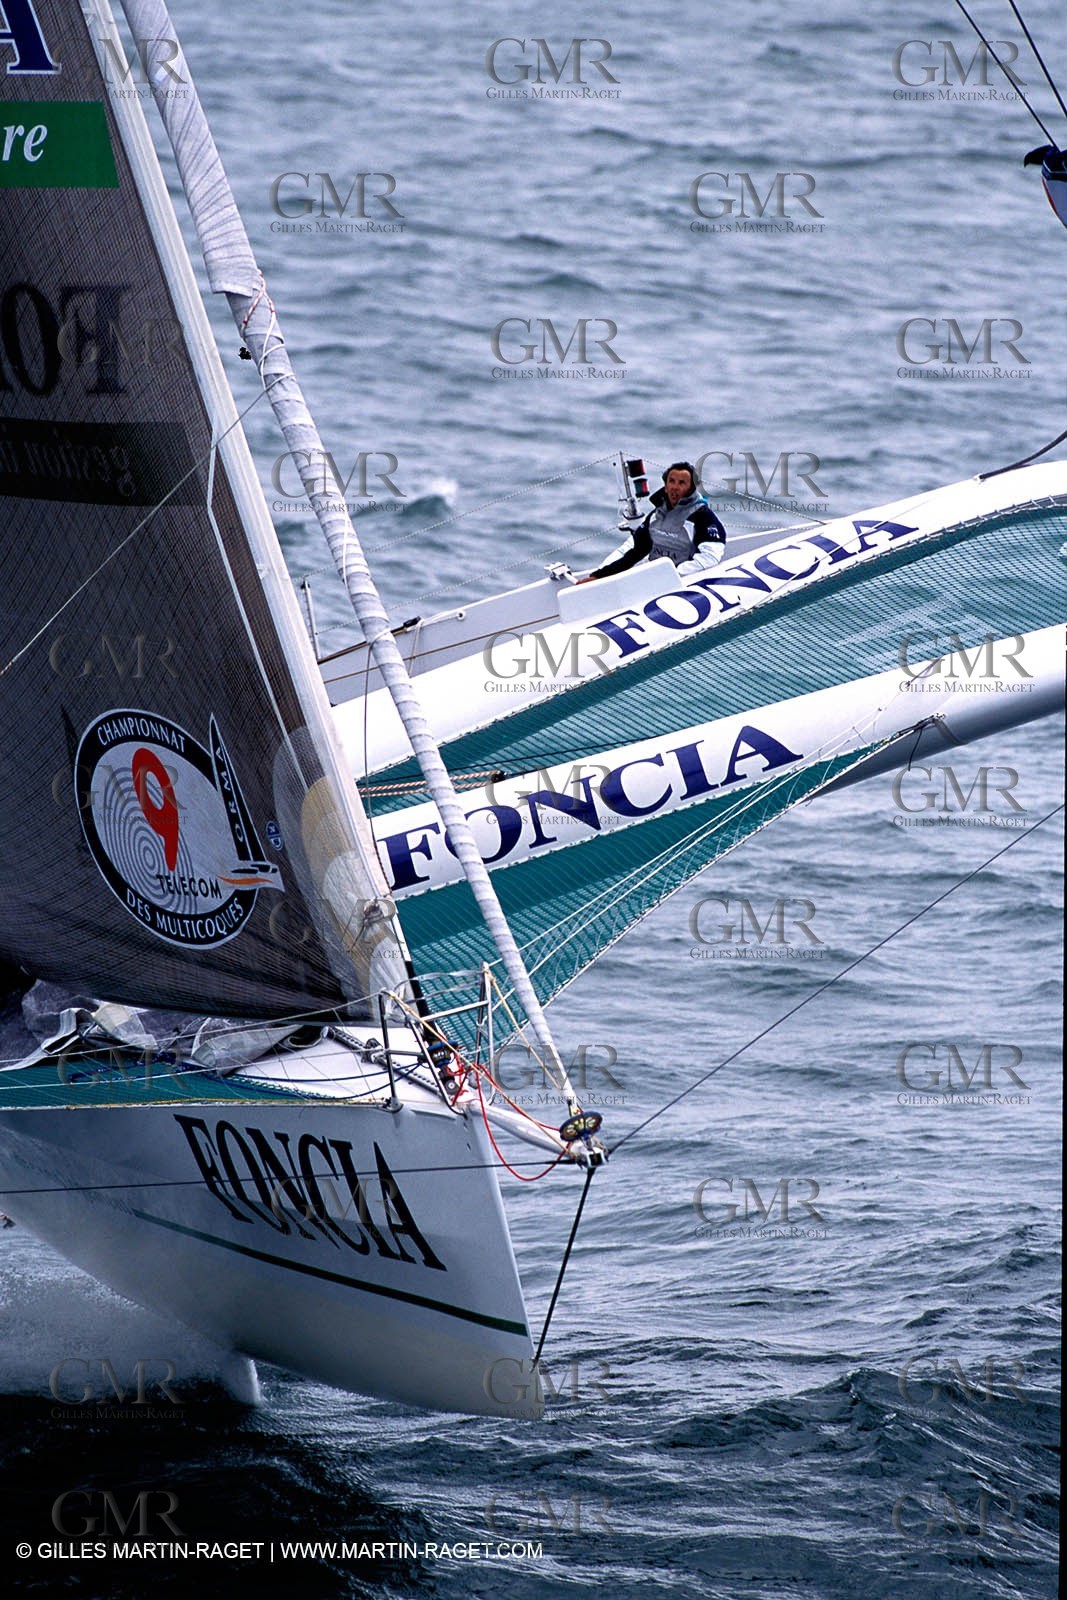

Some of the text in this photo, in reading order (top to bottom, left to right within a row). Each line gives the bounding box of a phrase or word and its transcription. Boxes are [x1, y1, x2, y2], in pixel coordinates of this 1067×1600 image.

[2, 124, 48, 163] re
[586, 519, 919, 659] FONCIA
[97, 716, 186, 754] CHAMPIONNAT
[376, 725, 804, 891] FONCIA
[156, 874, 223, 900] TELECOM
[126, 891, 245, 939] DES MULTICOQUES
[173, 1114, 448, 1272] FONCIA
